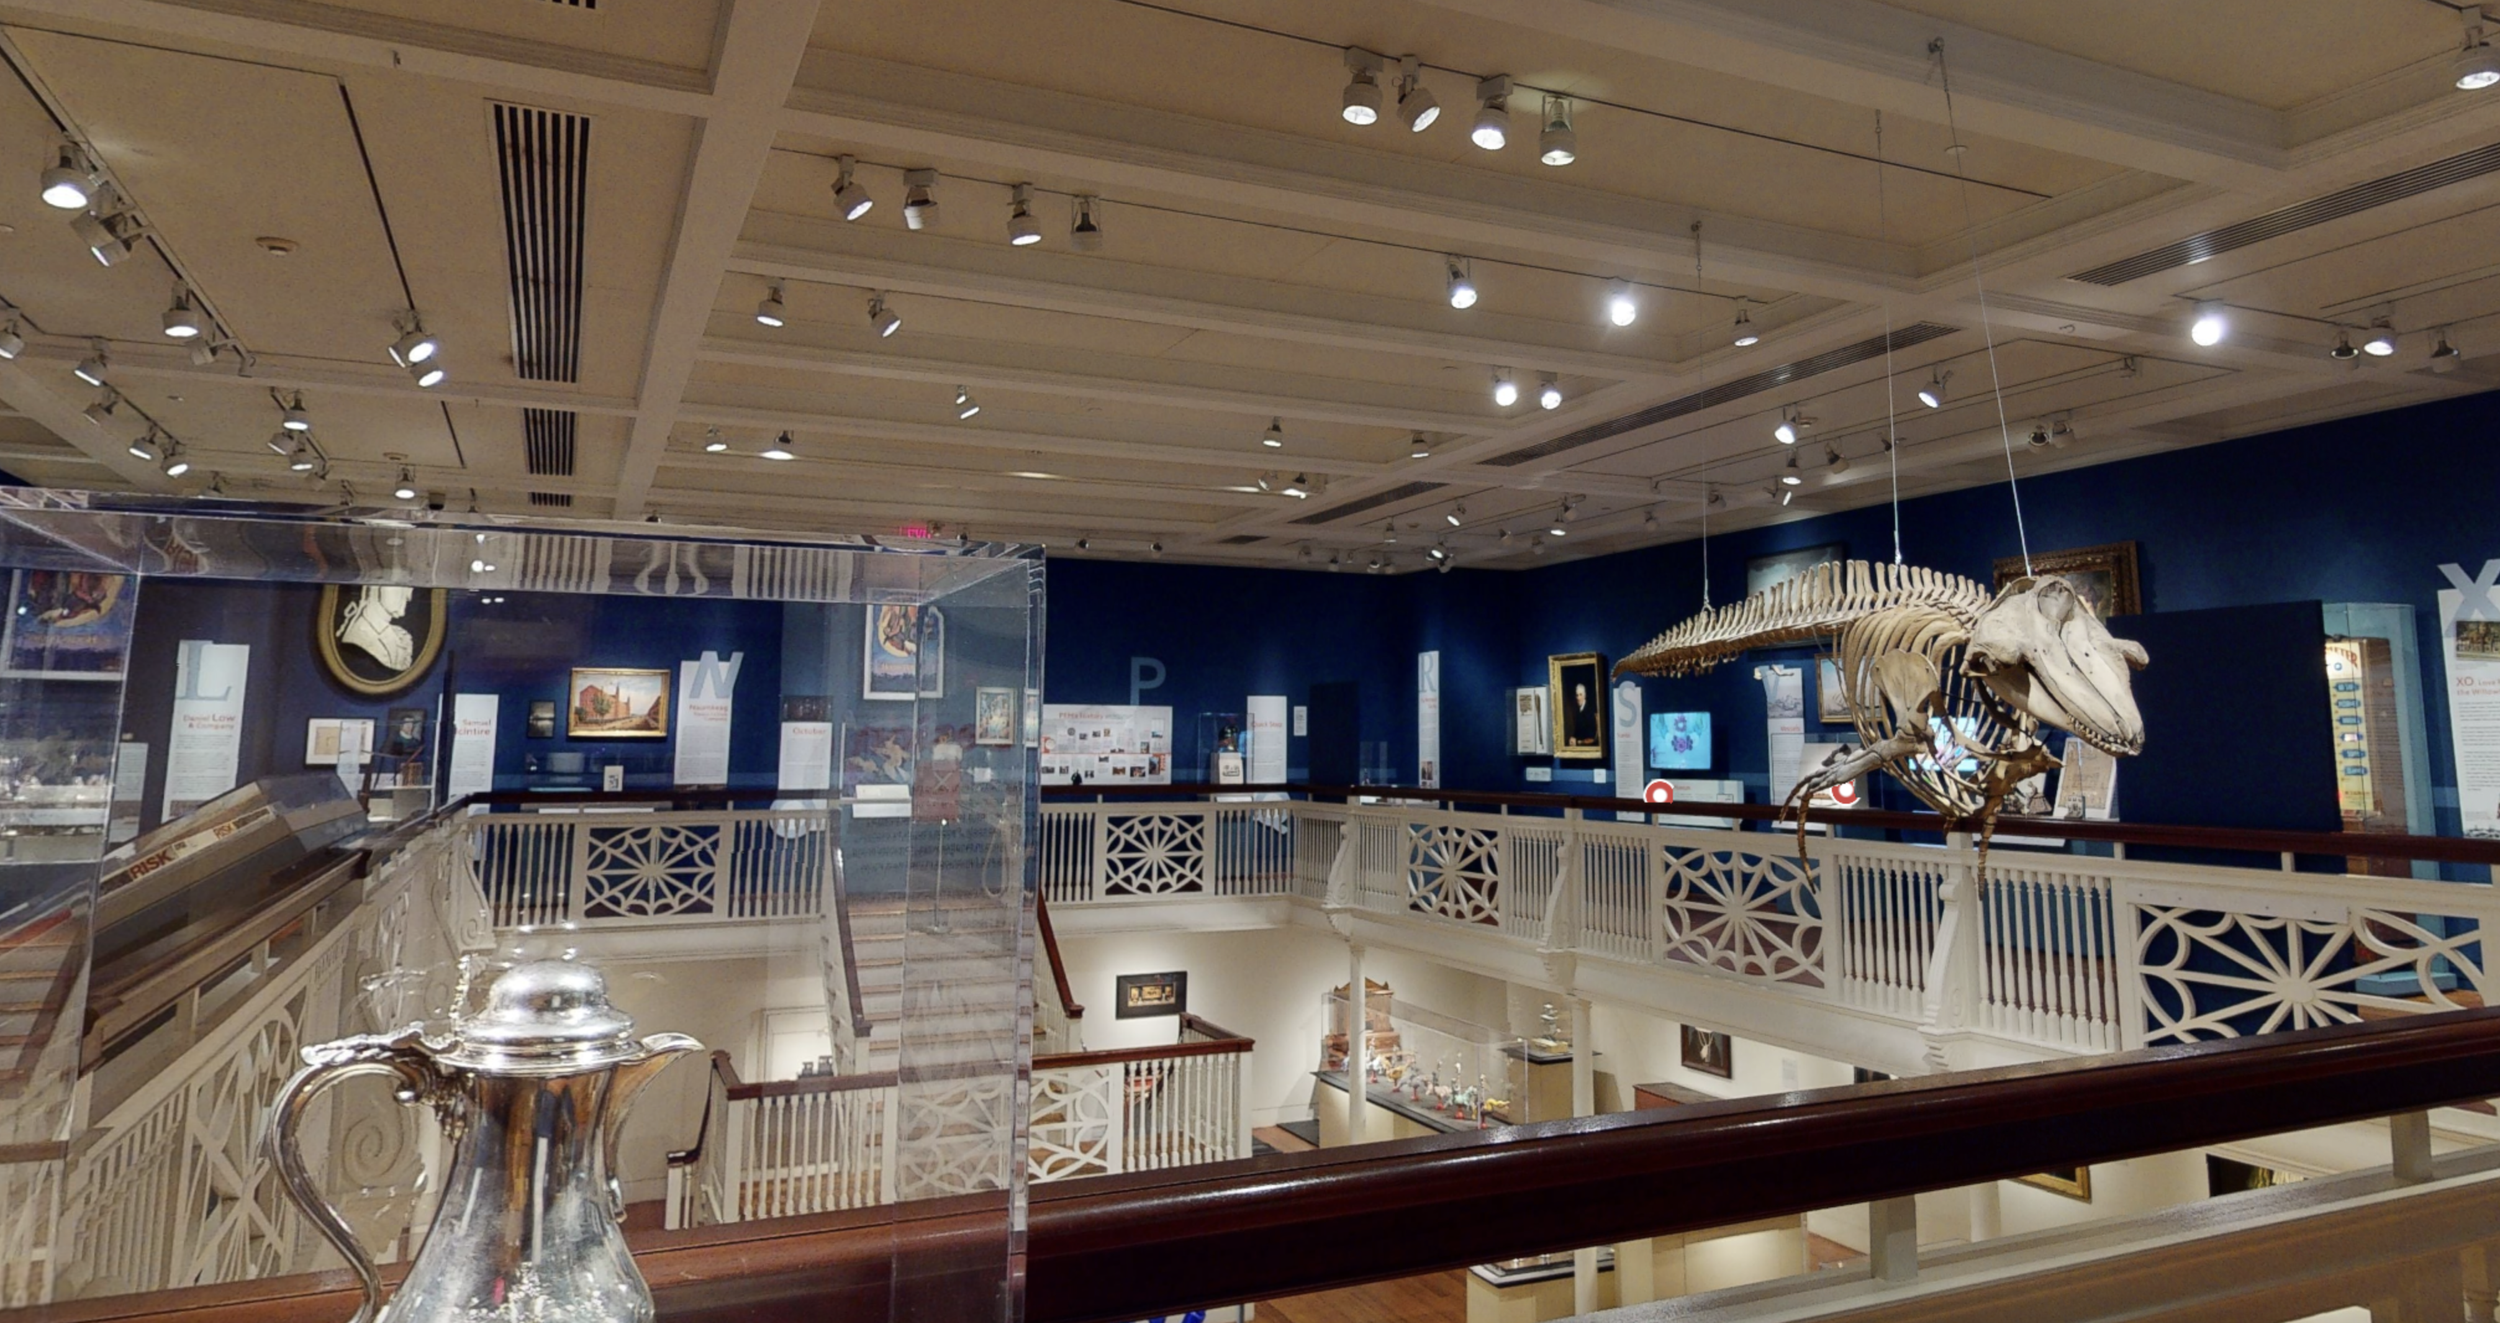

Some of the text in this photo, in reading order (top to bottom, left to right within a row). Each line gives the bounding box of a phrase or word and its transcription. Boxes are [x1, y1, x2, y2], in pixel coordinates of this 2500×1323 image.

[2438, 558, 2500, 638] X
[175, 639, 232, 701] L
[688, 650, 744, 699] N
[1130, 656, 1167, 706] P
[1419, 652, 1437, 693] R
[211, 713, 236, 722] Low
[1618, 680, 1638, 728] S
[456, 727, 491, 736] cIntire
[129, 848, 173, 881] RISK
